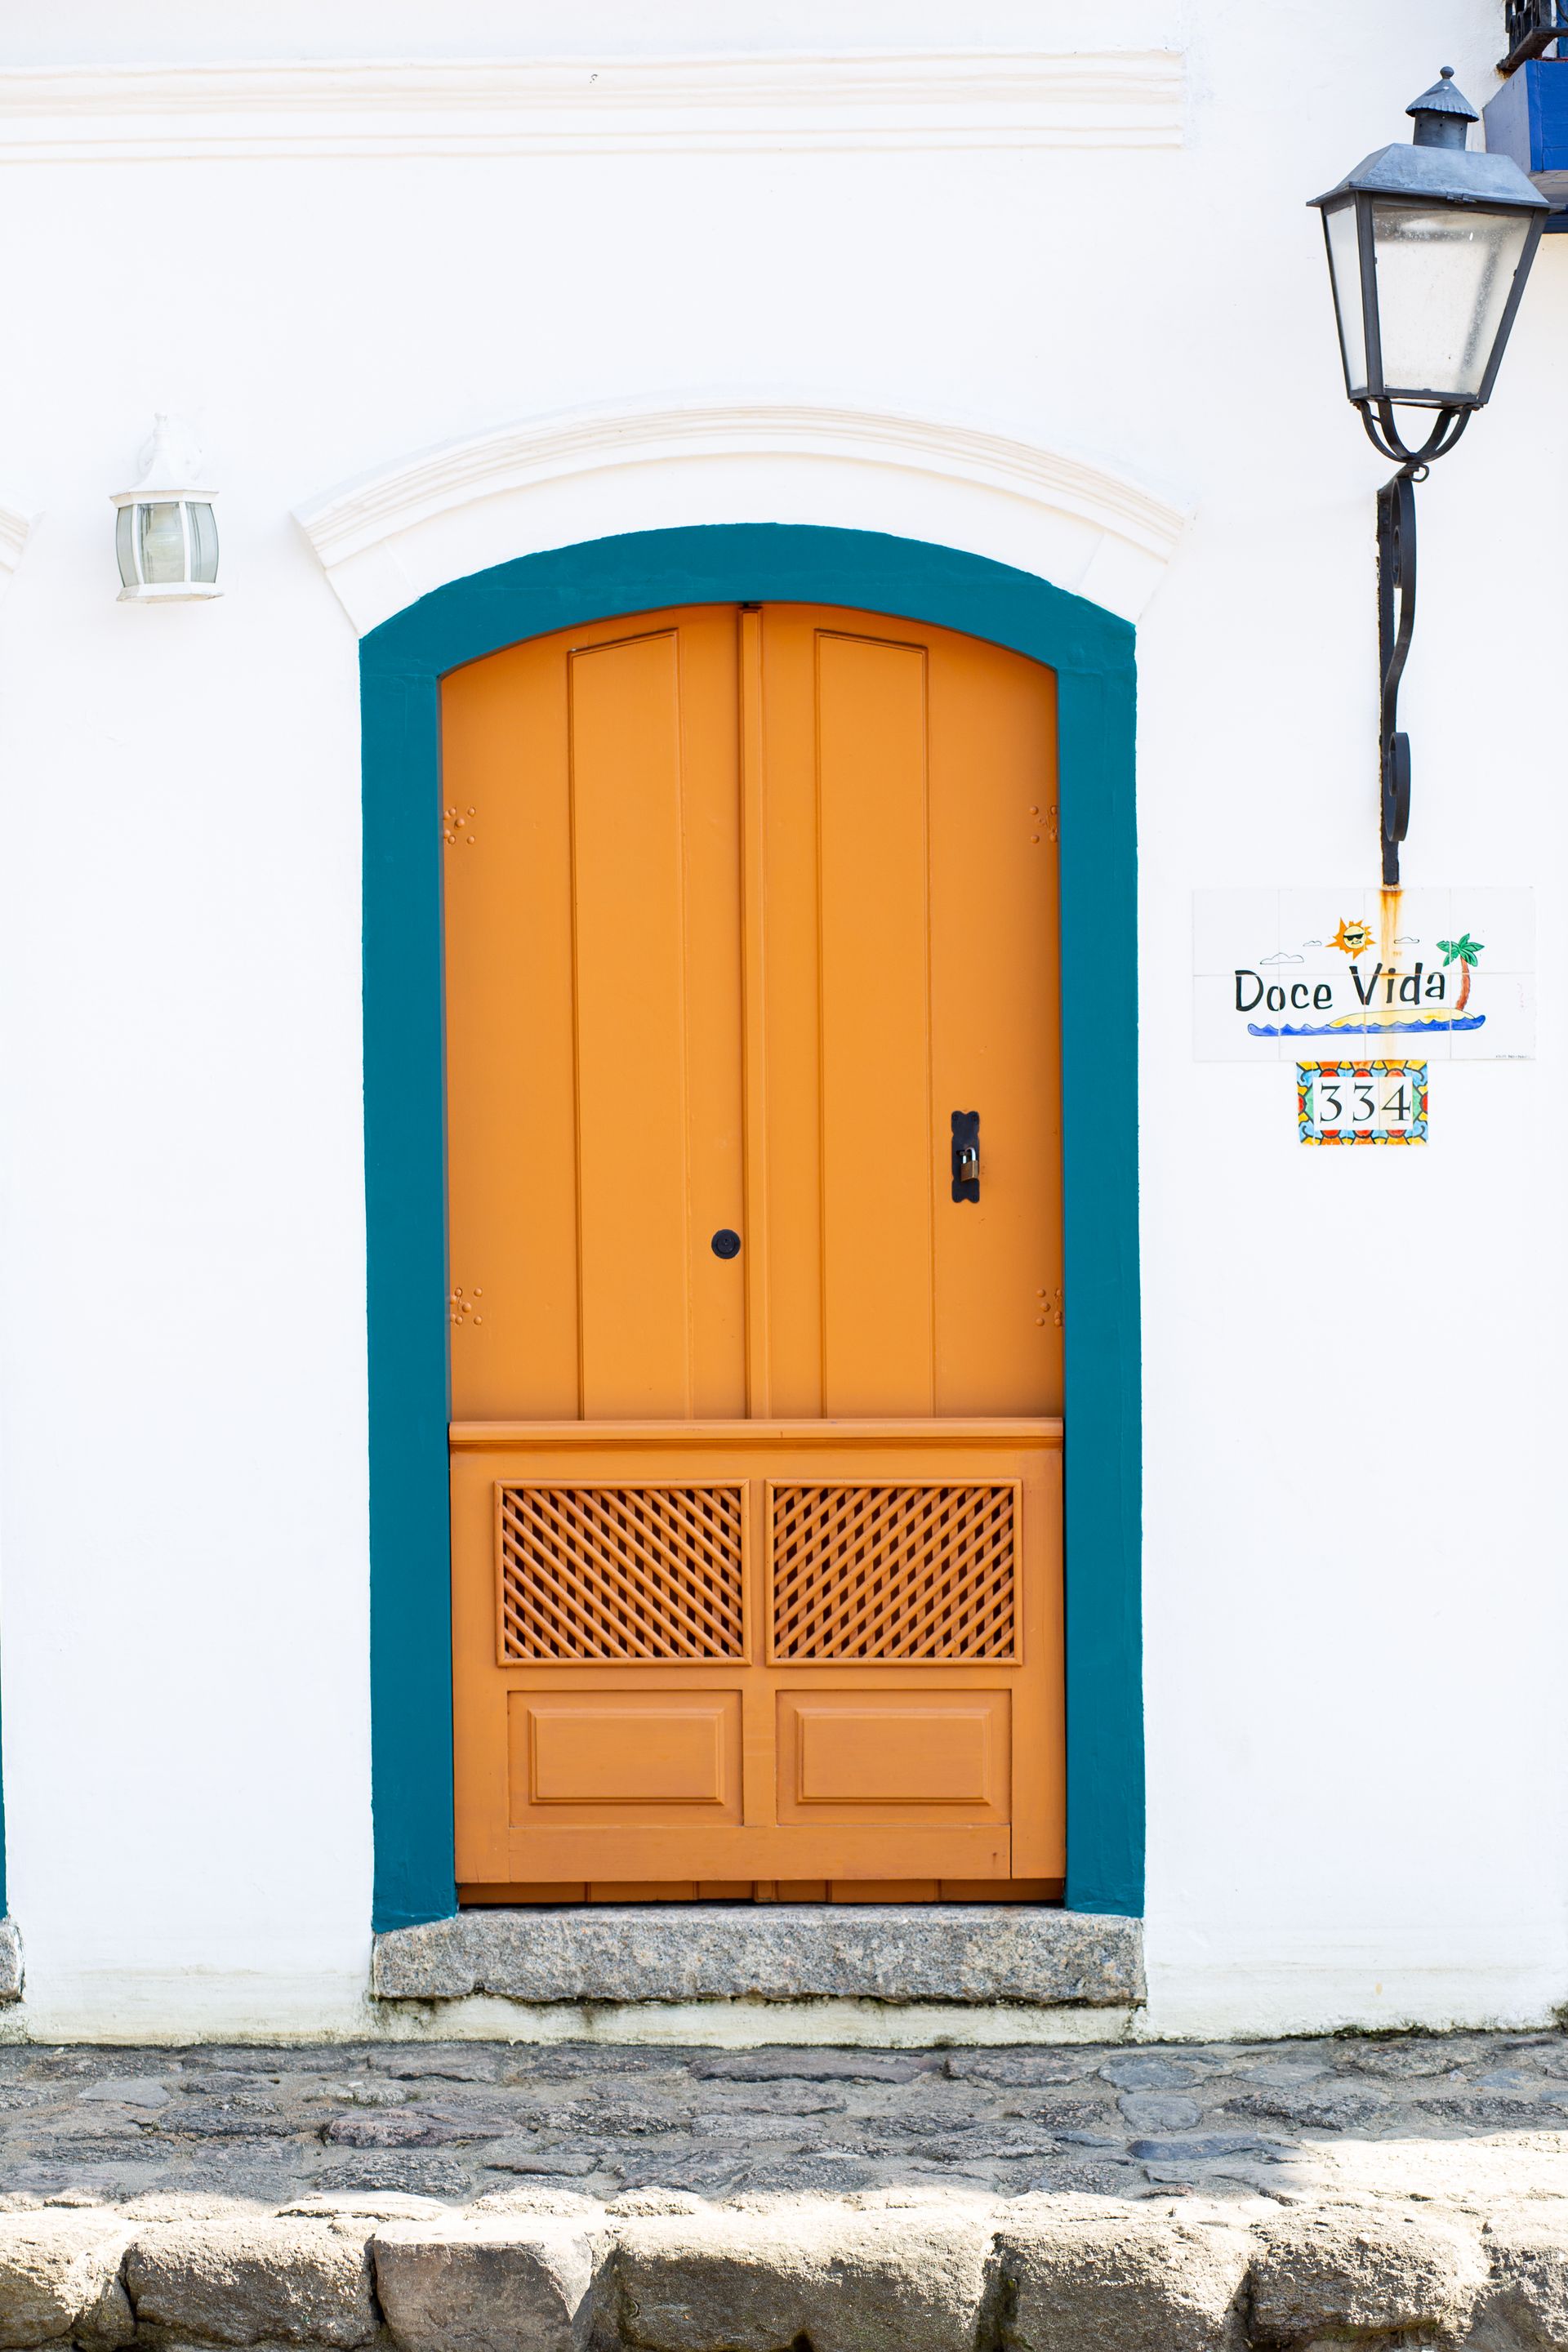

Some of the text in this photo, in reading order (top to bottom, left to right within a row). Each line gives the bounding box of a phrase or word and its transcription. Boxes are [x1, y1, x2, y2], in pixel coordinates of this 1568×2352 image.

[1235, 962, 1446, 1012] Doce Vida
[1319, 1083, 1411, 1123] 334
